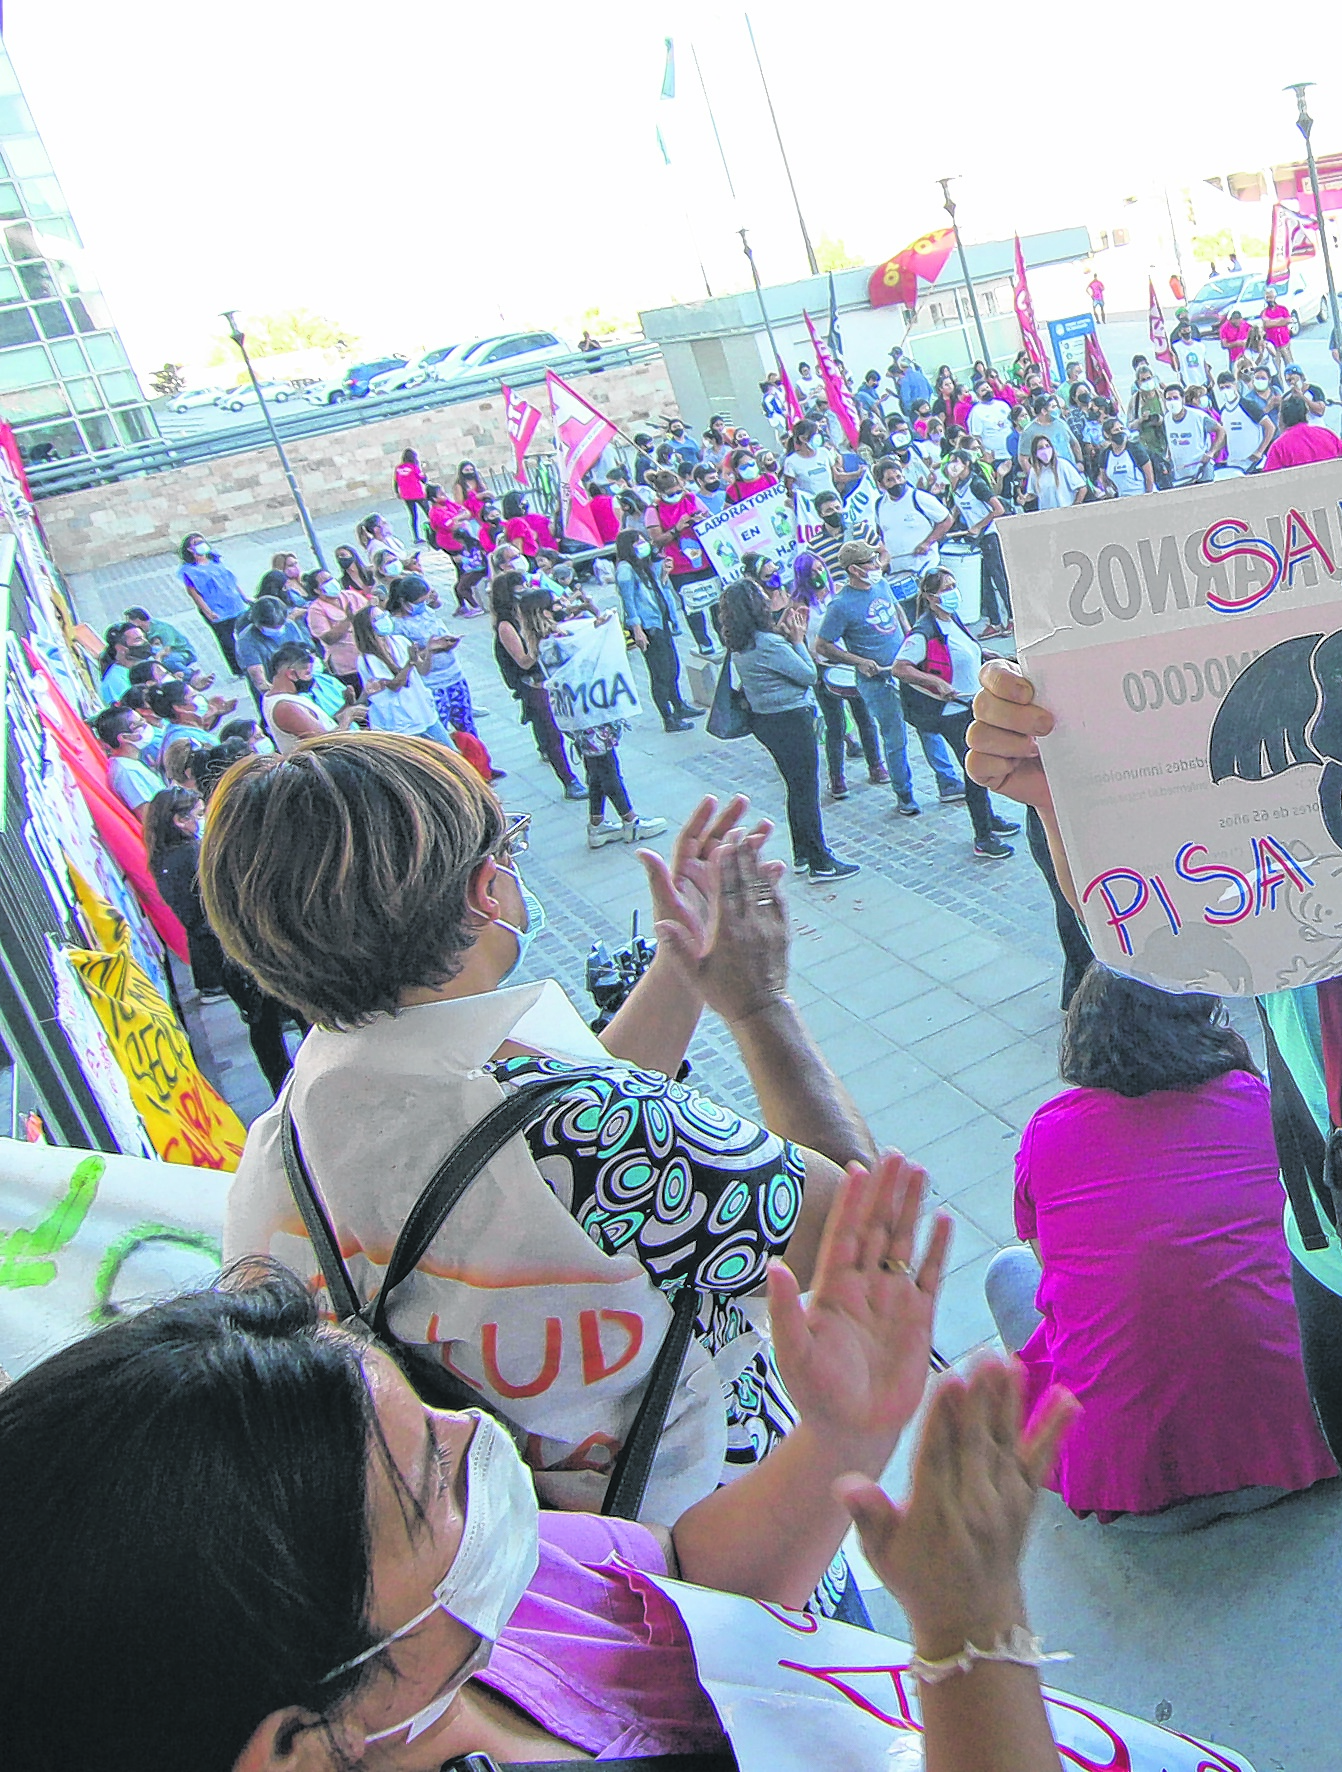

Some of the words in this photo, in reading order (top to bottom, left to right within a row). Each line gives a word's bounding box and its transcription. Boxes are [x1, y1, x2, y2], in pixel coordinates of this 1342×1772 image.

[695, 482, 786, 536] LABORATORIO
[741, 525, 761, 542] EN
[1082, 835, 1315, 956] PISA
